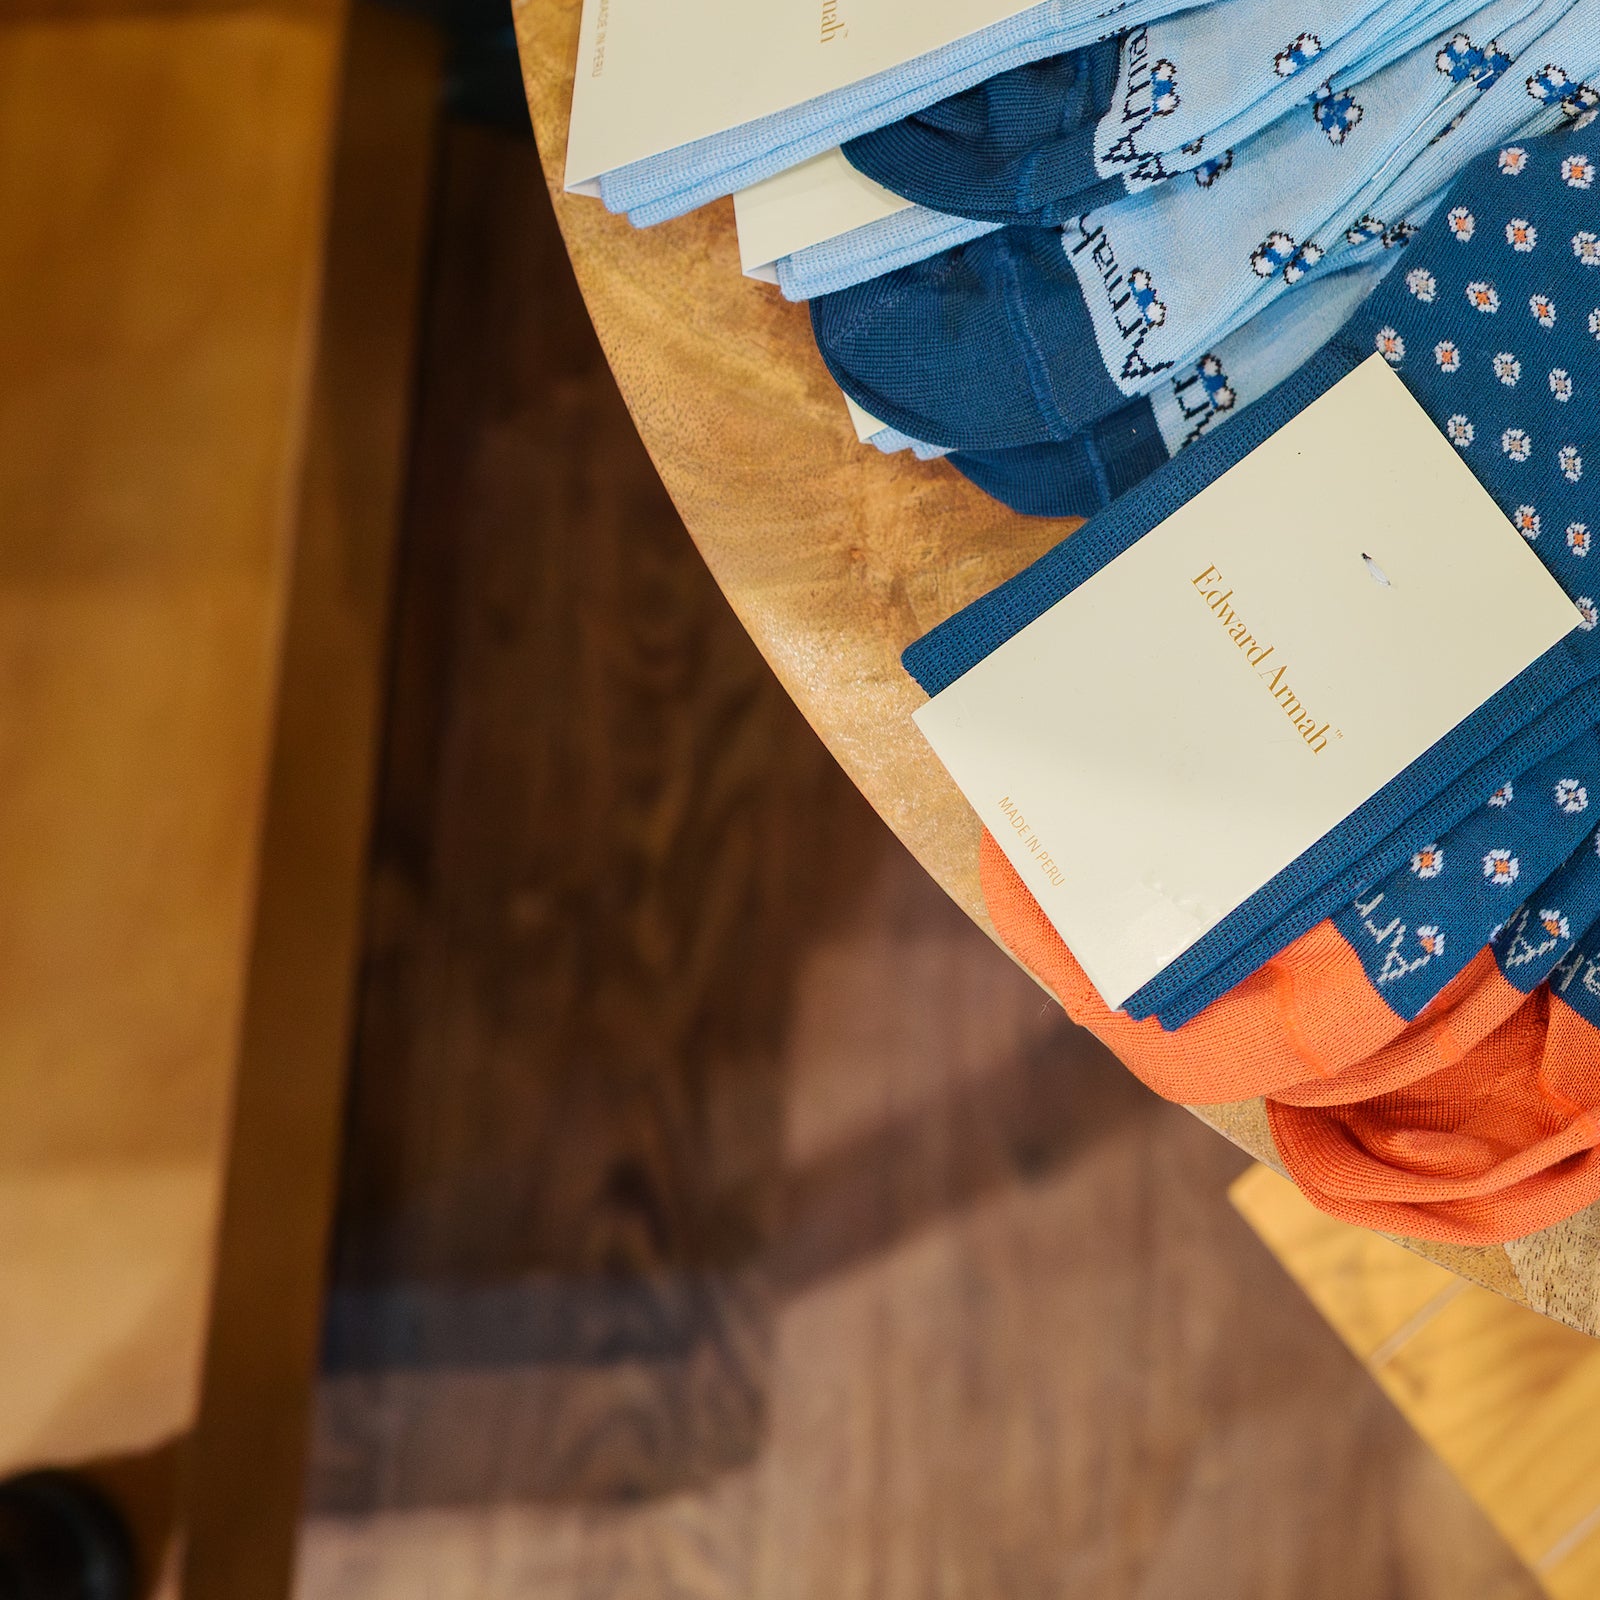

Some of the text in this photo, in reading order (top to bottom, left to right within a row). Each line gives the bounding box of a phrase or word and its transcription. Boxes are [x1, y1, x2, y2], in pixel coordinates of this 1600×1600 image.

[1101, 25, 1153, 164] Arma
[1190, 561, 1276, 668] Edward
[998, 796, 1066, 888] MADE IN PERU
